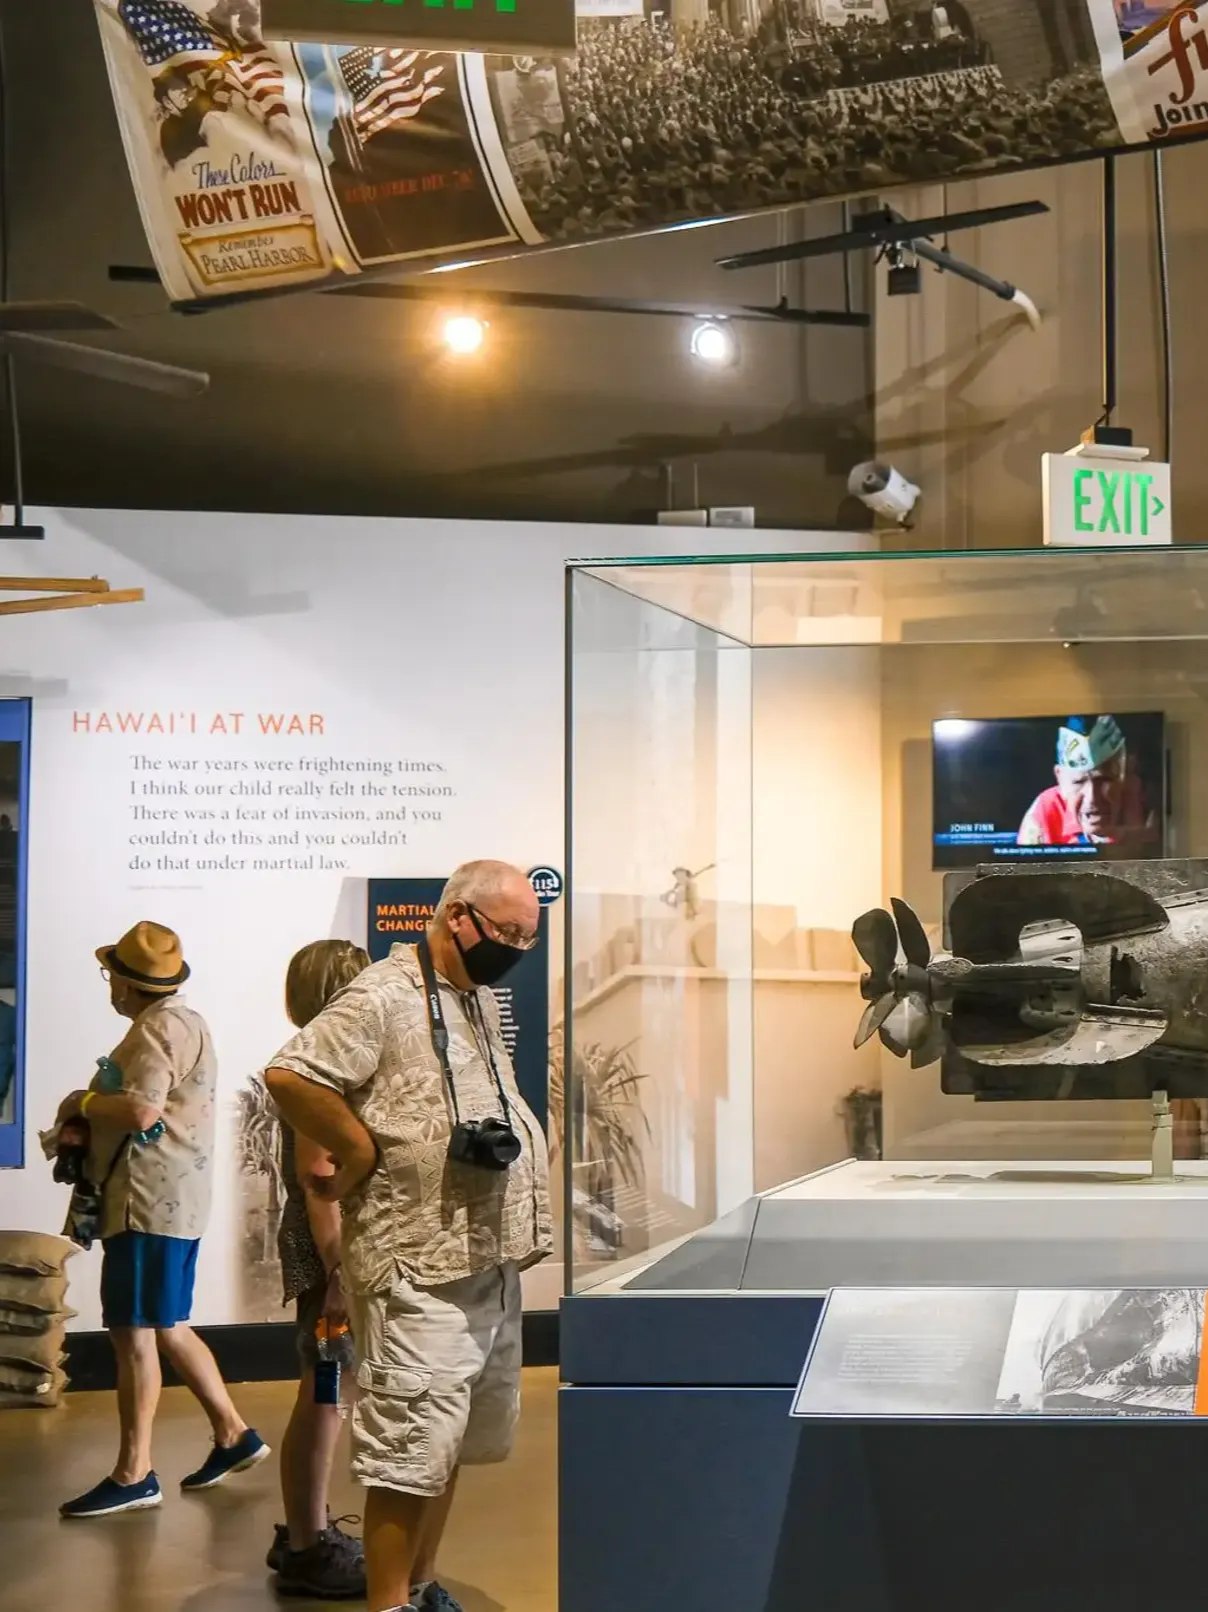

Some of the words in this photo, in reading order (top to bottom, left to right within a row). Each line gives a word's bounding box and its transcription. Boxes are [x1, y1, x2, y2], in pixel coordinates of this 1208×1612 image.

[230, 151, 287, 184] Colors
[175, 188, 249, 229] WON'T
[249, 181, 303, 218] RUN
[218, 235, 275, 253] Remember
[200, 253, 250, 275] PEARL
[249, 246, 315, 270] HARBOR
[1073, 468, 1154, 535] EXIT
[209, 712, 245, 734] AT
[257, 713, 326, 735] WAR
[129, 755, 162, 771] The
[168, 759, 198, 771] war
[204, 760, 248, 775] years
[254, 759, 293, 771] were
[299, 756, 393, 776] frightening
[398, 758, 448, 772] times.
[131, 780, 136, 795] I
[143, 780, 189, 795] think
[194, 785, 223, 796] our
[229, 780, 272, 795] child
[278, 780, 323, 799] really
[329, 780, 354, 796] felt
[361, 781, 387, 796] the
[392, 783, 457, 797] tension.
[129, 805, 178, 820] There
[184, 809, 216, 820] was
[220, 809, 230, 820] a
[236, 804, 266, 820] fear
[272, 804, 292, 820] of
[295, 806, 371, 822] invasion,
[375, 806, 406, 821] and
[412, 810, 442, 826] you
[950, 823, 973, 832] JOHN
[974, 823, 995, 832] FINN
[128, 830, 198, 845] couldn't
[203, 830, 226, 845] do
[231, 830, 263, 845] this
[268, 830, 299, 845] and
[305, 834, 336, 849] you
[341, 830, 408, 845] couldn't
[128, 855, 151, 870] do
[157, 855, 190, 870] that
[196, 854, 245, 870] under
[252, 854, 313, 870] martial
[319, 855, 350, 869] law.
[376, 904, 436, 916] MARTIAL
